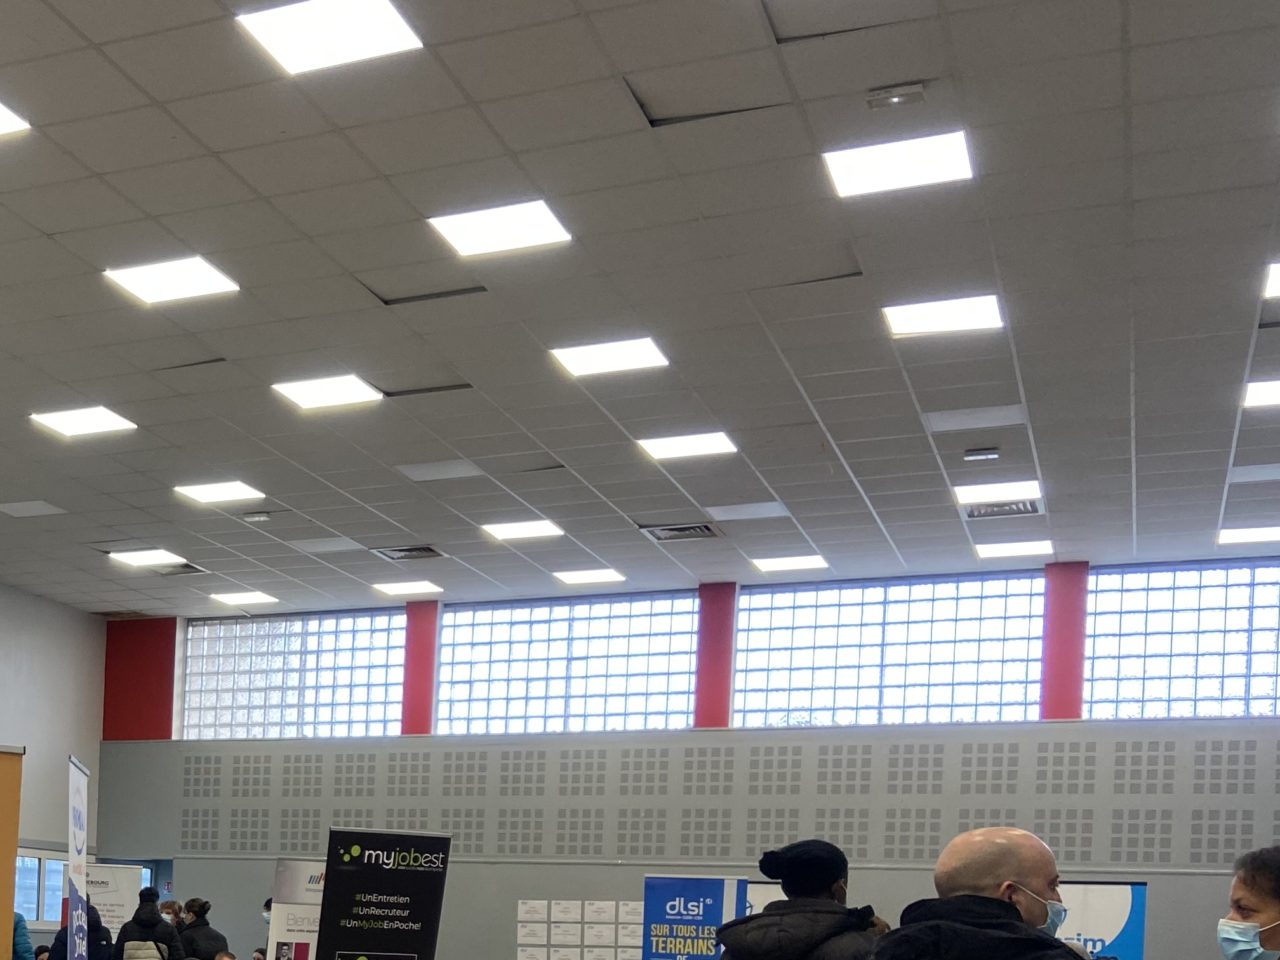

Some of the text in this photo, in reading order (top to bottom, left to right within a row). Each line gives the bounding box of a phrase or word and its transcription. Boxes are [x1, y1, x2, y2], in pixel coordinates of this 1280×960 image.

[364, 847, 445, 869] myjobest
[355, 893, 410, 903] #UnEntretien
[665, 897, 704, 915] dlsi
[352, 907, 410, 916] #UnRecruteur
[650, 923, 670, 936] SUR
[671, 924, 697, 937] TOUS
[698, 926, 717, 938] LES
[650, 937, 717, 956] TERRAINS
